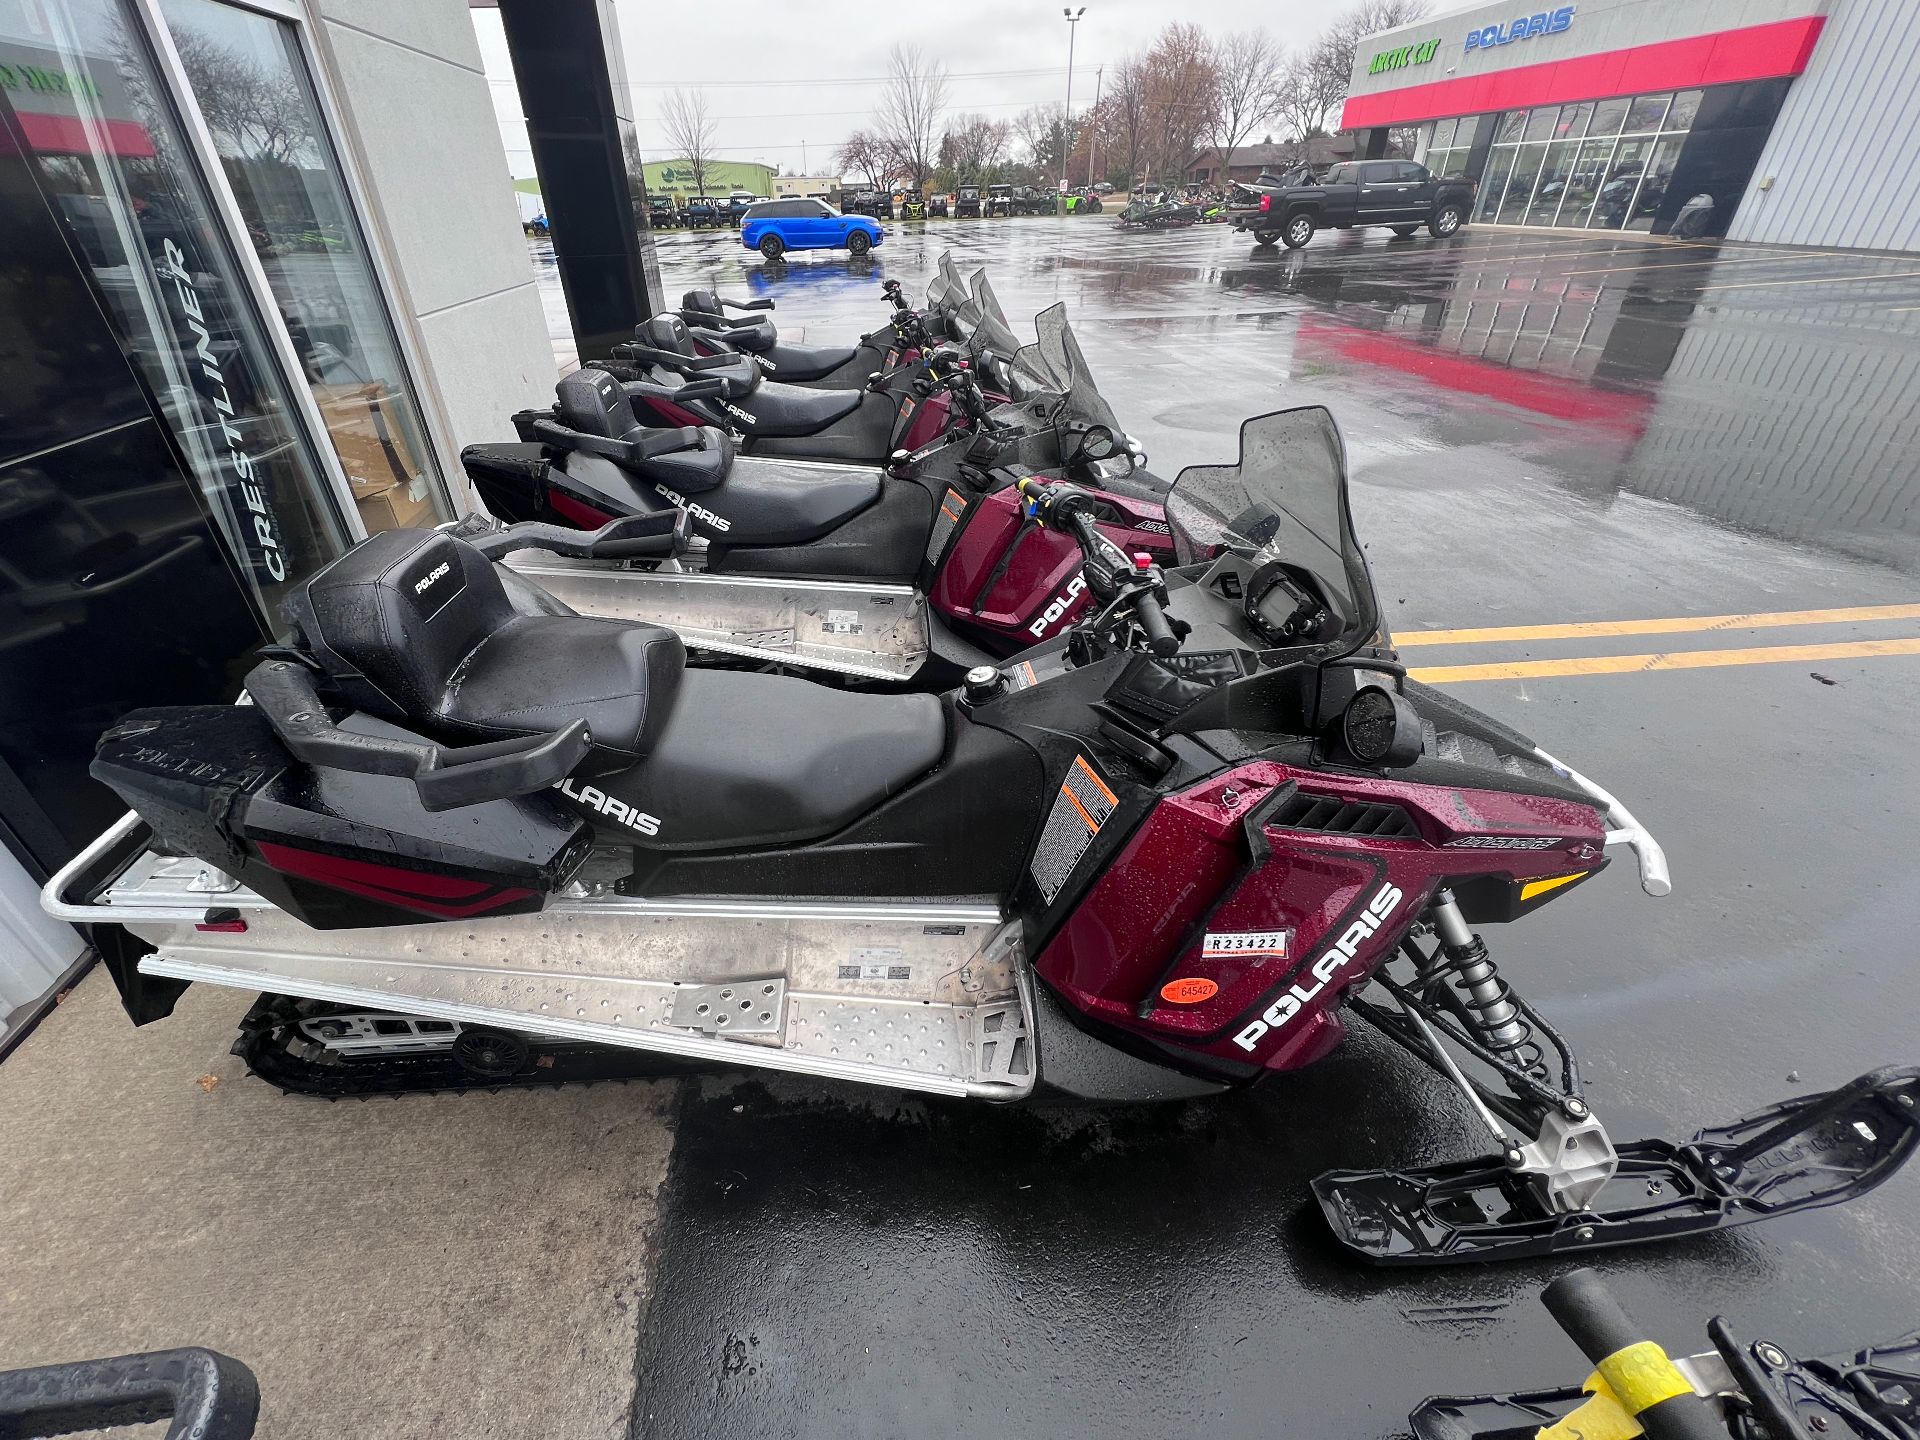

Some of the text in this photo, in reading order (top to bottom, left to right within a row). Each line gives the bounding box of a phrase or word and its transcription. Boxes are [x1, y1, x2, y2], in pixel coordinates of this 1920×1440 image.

[1463, 6, 1577, 53] POLARIS
[1368, 38, 1442, 75] ARCTIC CAT
[163, 237, 286, 582] CRESTLINER
[414, 561, 450, 595] POLARIS
[1028, 569, 1088, 638] POLA
[551, 777, 662, 836] LARIS
[1211, 938, 1278, 950] R23422
[1232, 881, 1403, 1053] POLARIS
[1181, 984, 1214, 997] 645427
